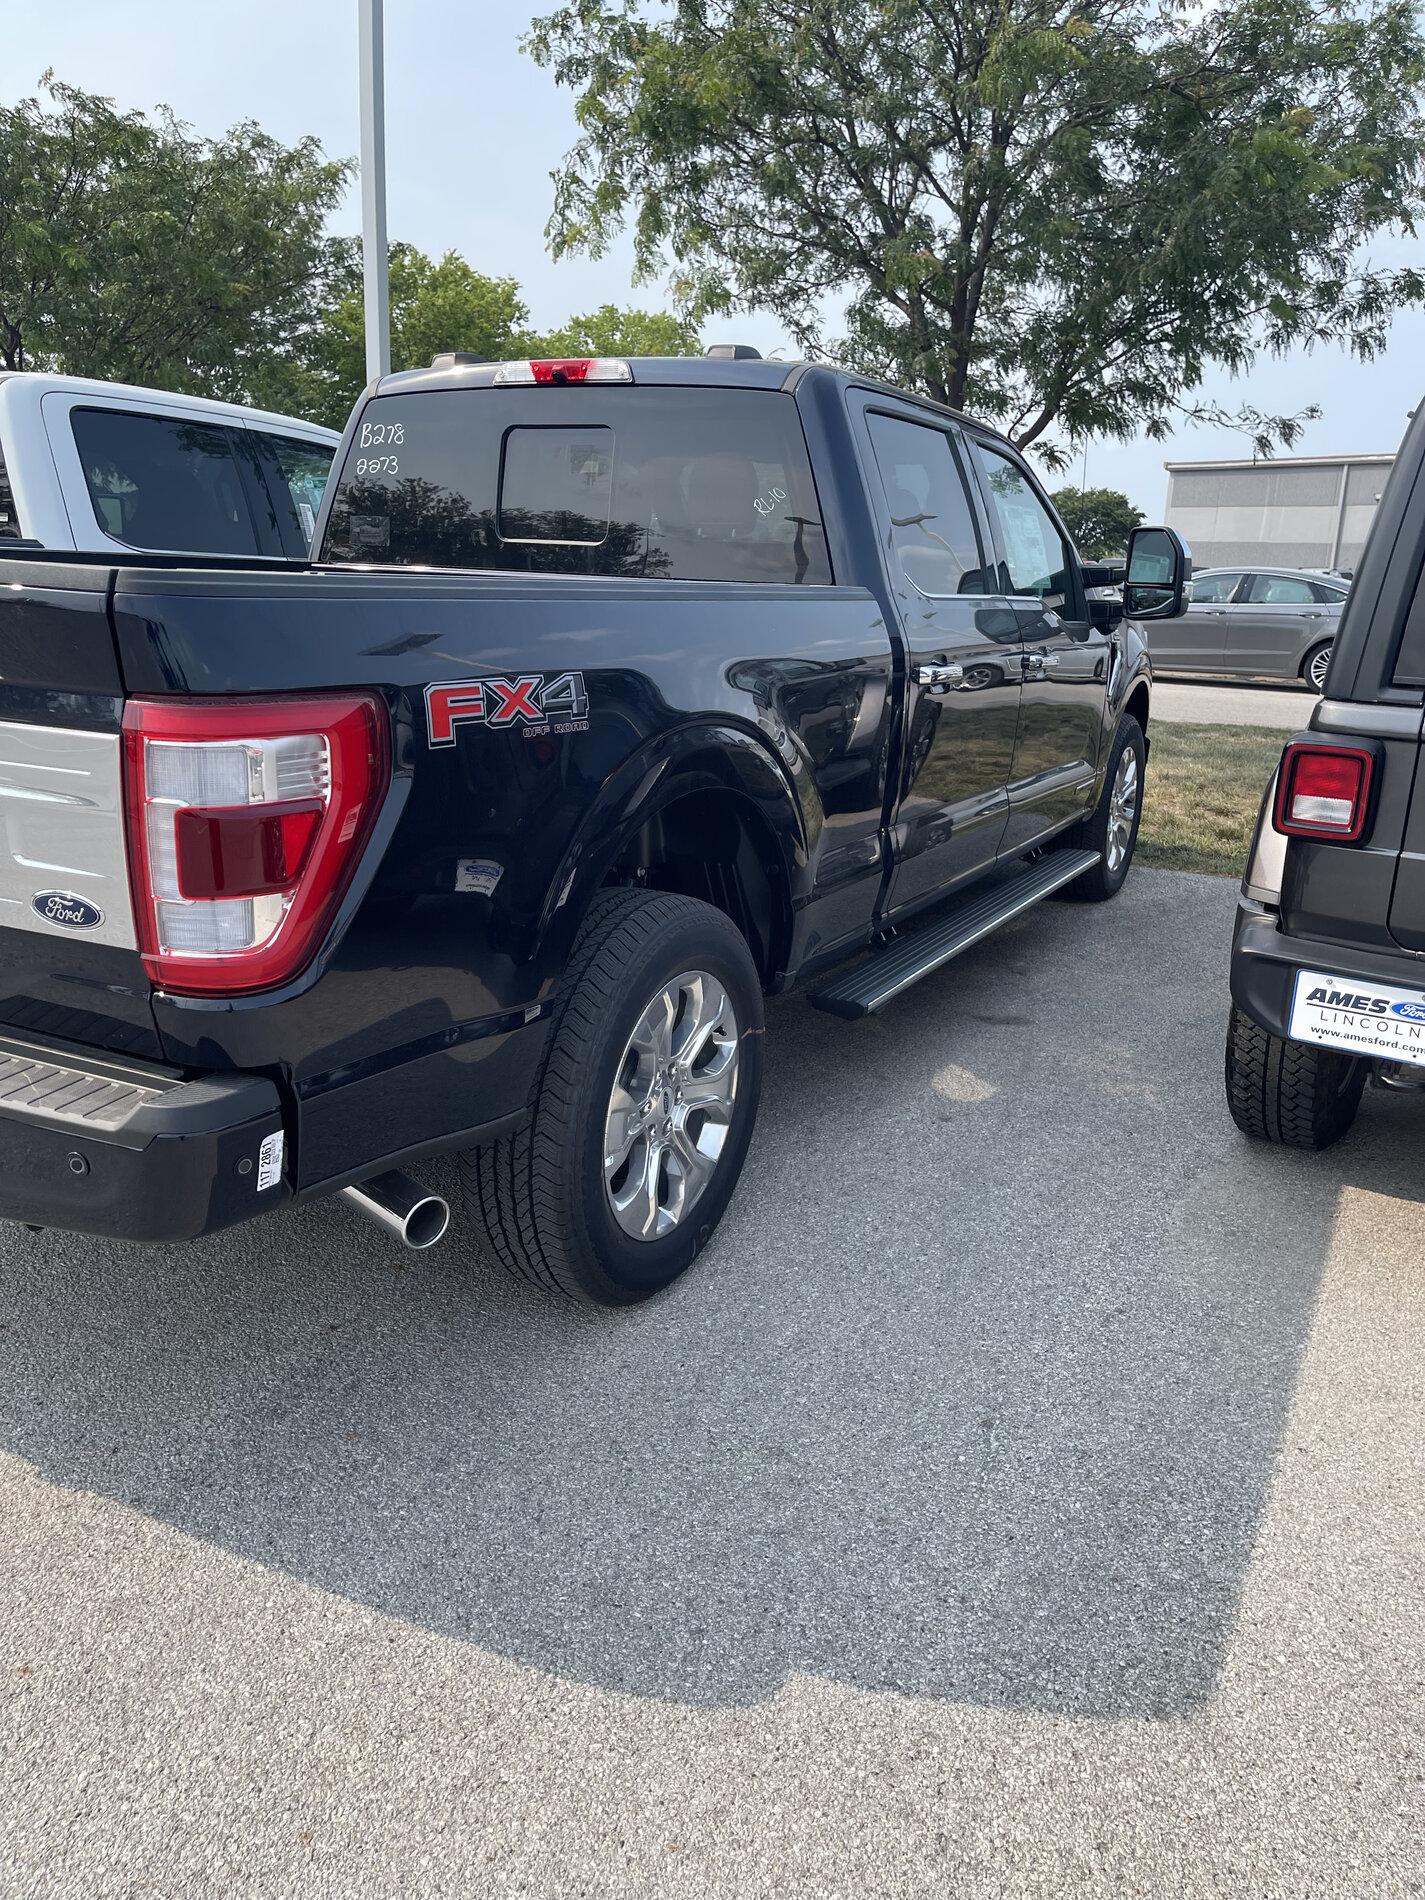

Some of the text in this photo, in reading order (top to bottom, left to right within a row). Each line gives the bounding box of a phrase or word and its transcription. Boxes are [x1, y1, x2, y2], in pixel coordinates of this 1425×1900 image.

[360, 423, 405, 448] B278
[356, 456, 399, 475] 2273
[423, 671, 590, 750] FX4
[523, 720, 590, 738] OFF ROAD
[45, 896, 85, 923] Ford
[1306, 988, 1390, 1014] AMES
[1319, 1010, 1421, 1039] LINCOLN
[259, 1142, 272, 1188] 117 2861
